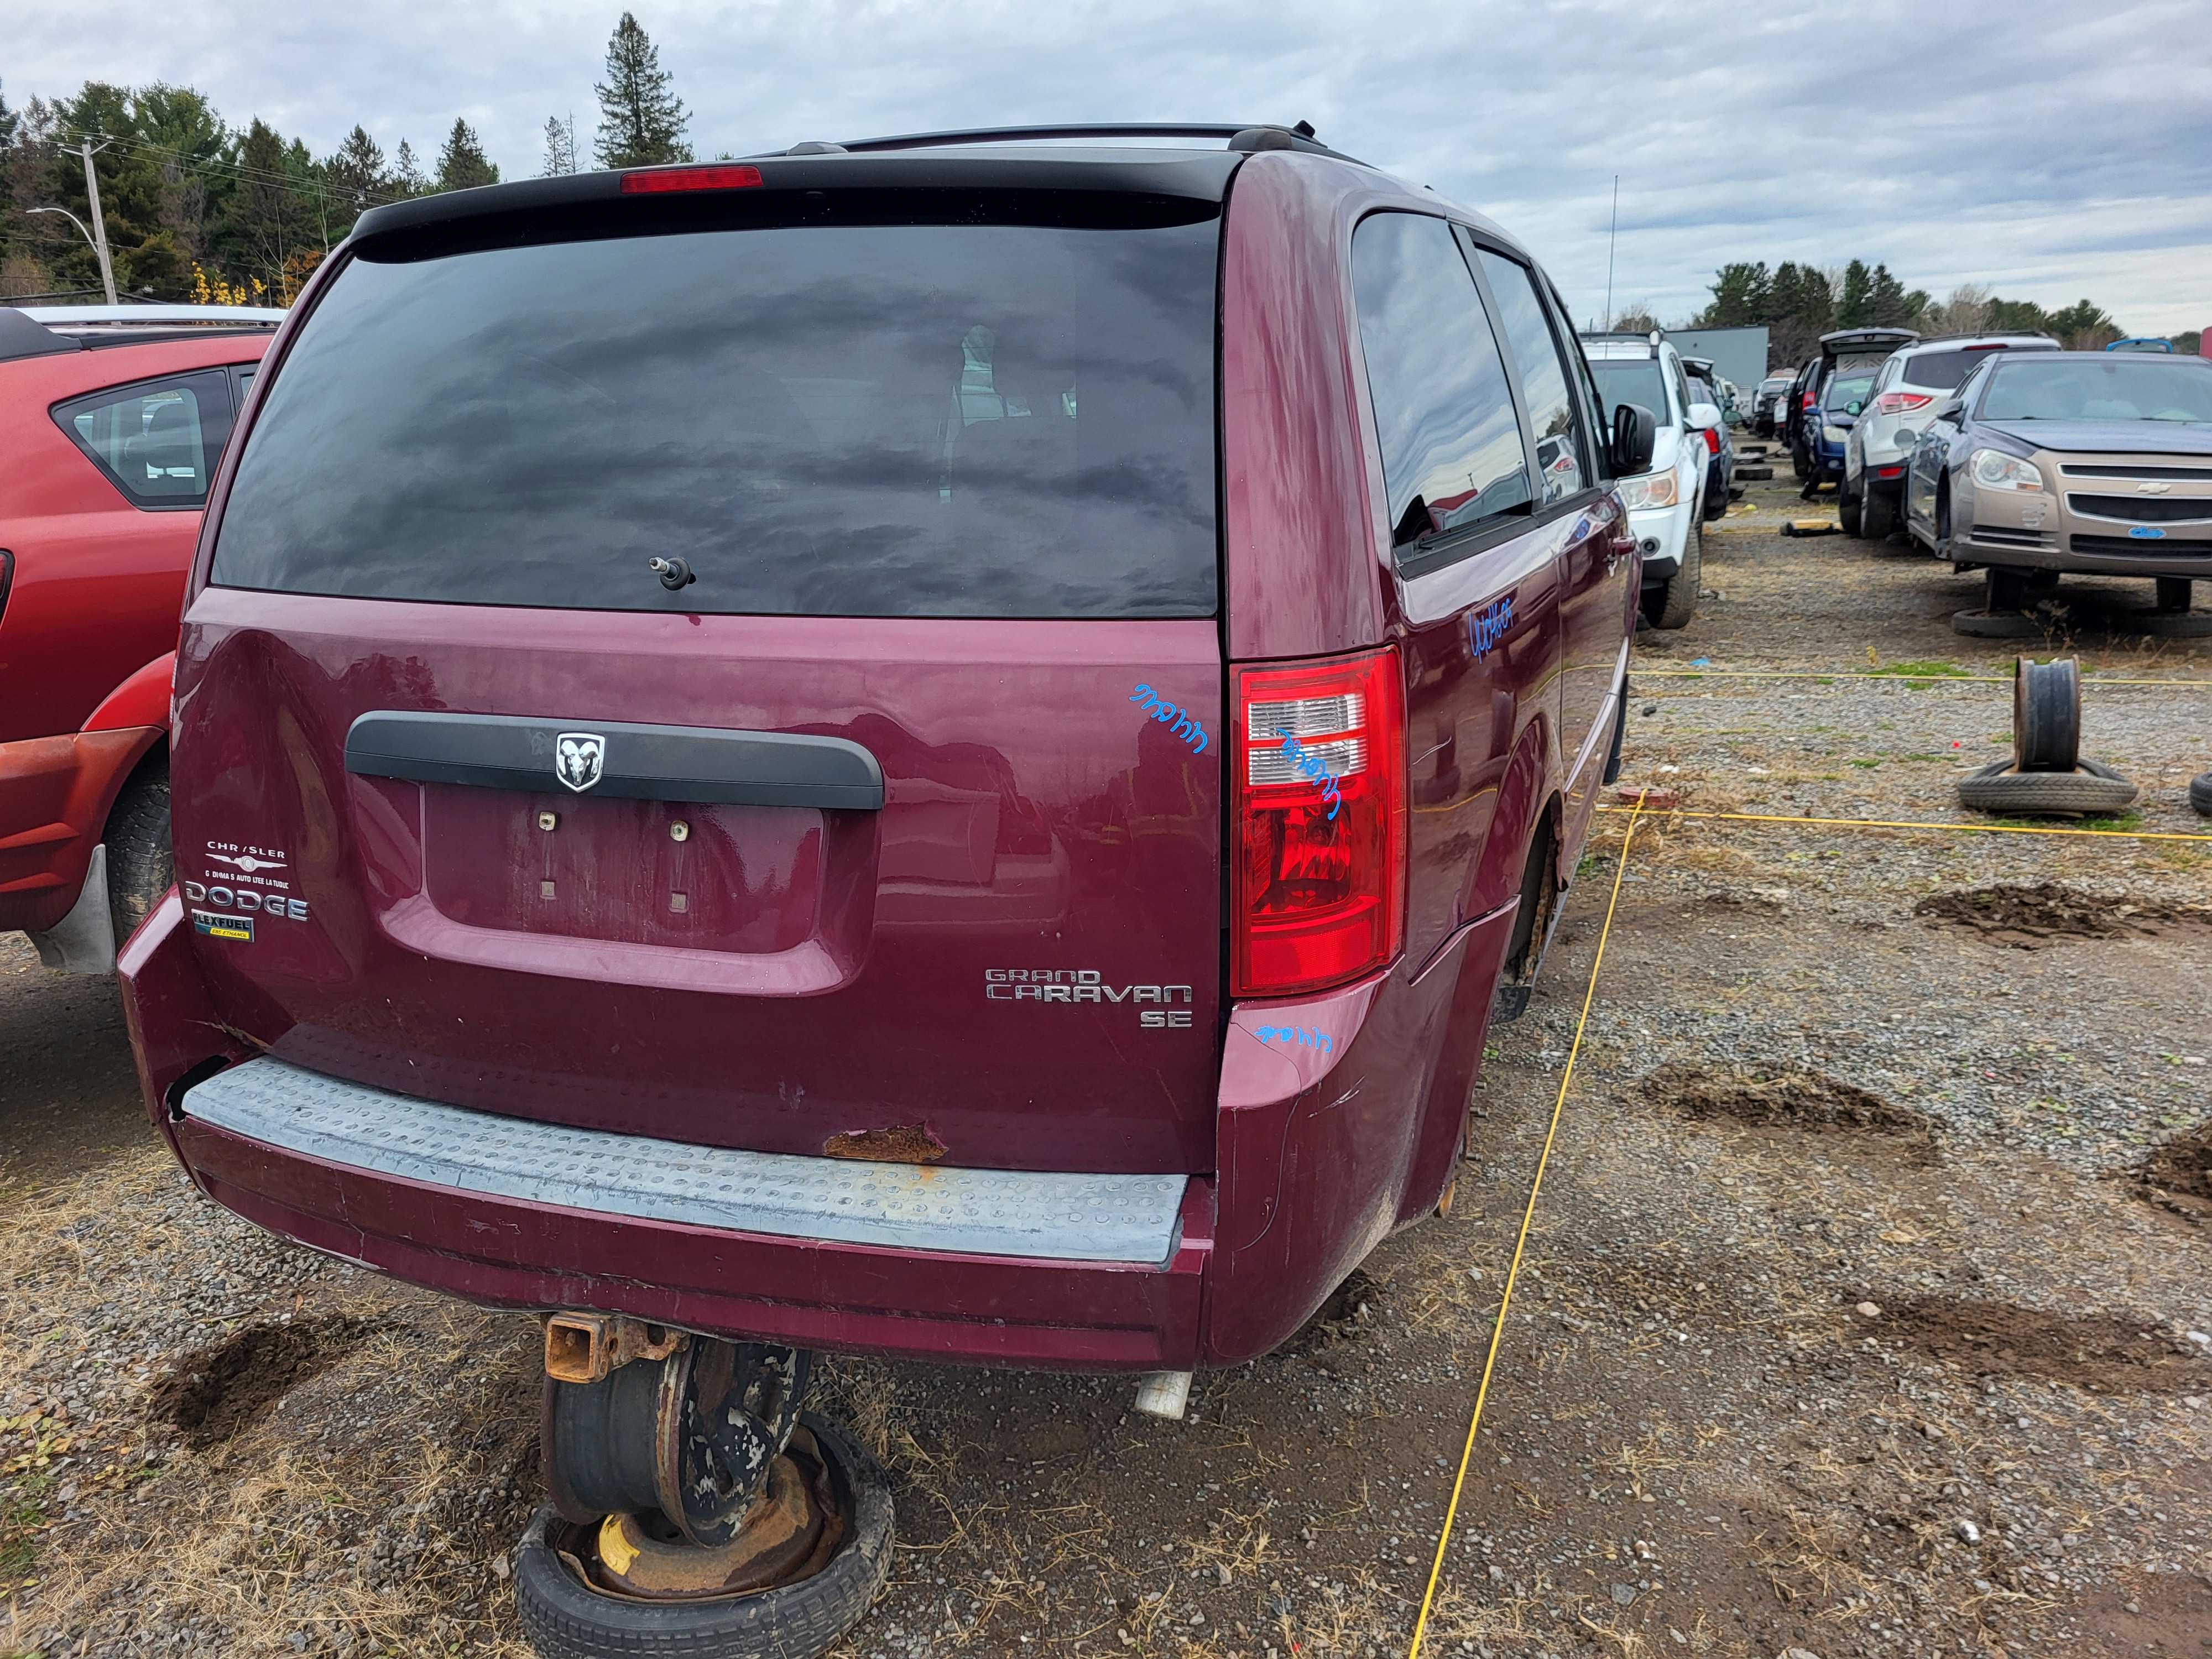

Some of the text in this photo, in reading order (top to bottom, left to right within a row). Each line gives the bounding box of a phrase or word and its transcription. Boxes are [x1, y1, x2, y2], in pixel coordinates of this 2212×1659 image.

[236, 874, 251, 883] AUTO
[252, 877, 265, 885] LTEE
[185, 880, 310, 922] DODGE
[985, 969, 1100, 984] GRAND
[985, 984, 1192, 1003] CARAVAN
[1140, 1011, 1193, 1028] SE
